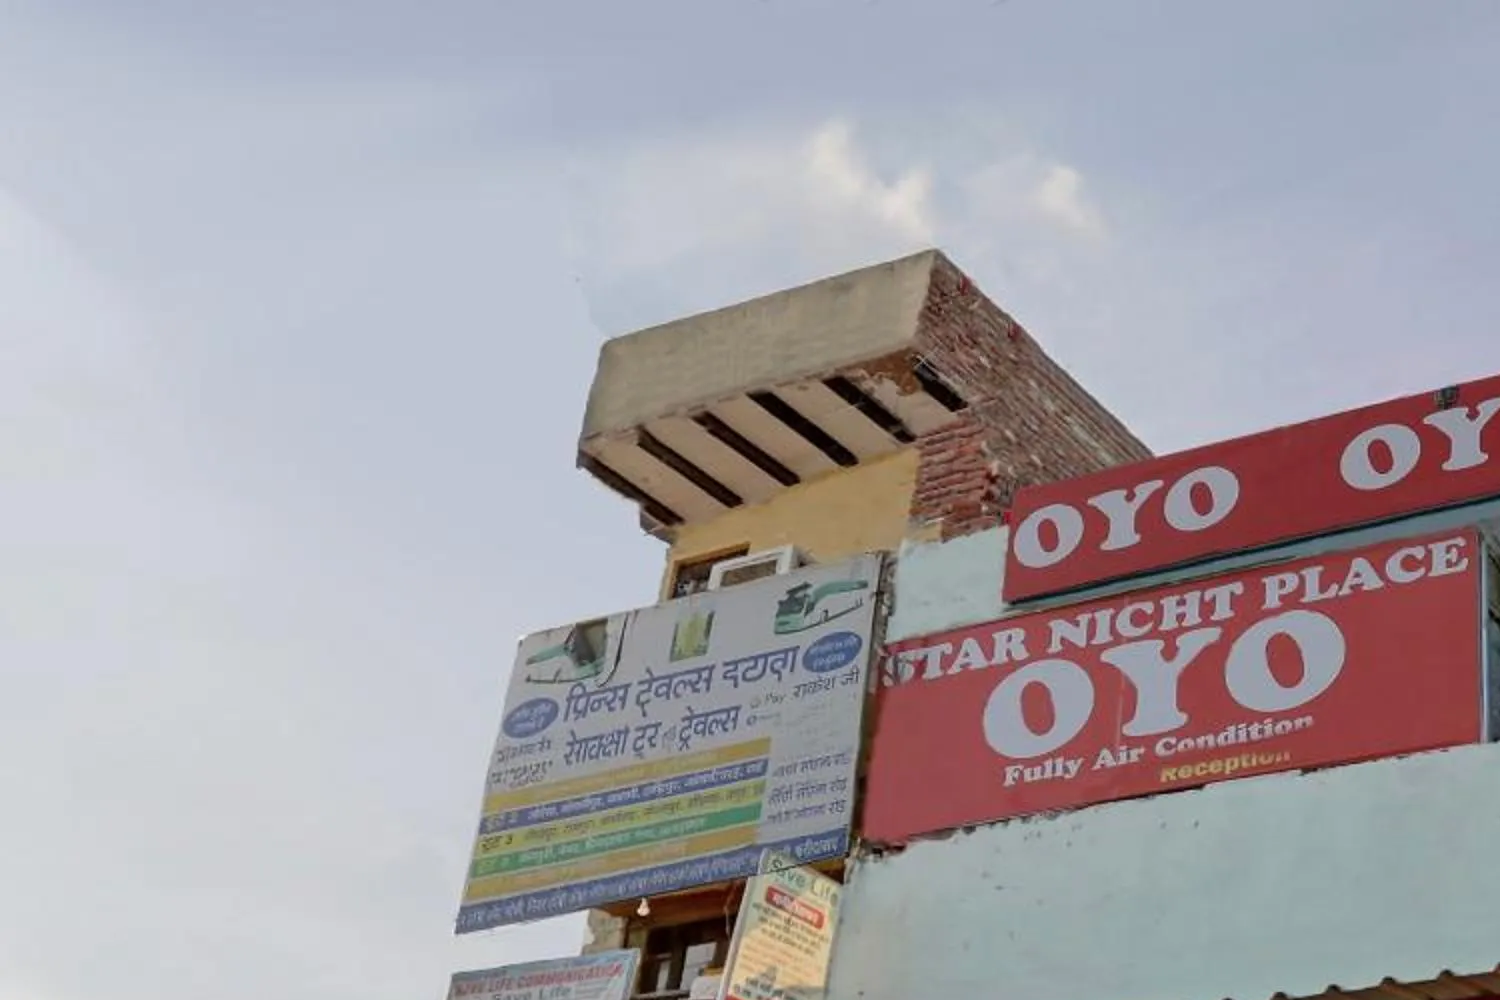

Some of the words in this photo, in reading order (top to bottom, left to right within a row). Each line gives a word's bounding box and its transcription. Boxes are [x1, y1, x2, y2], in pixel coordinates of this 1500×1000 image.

[1013, 465, 1240, 569] OYO
[1262, 537, 1469, 610] PLACE
[982, 609, 1346, 758] OYO
[1003, 757, 1084, 787] Fully
[1092, 745, 1144, 770] Air
